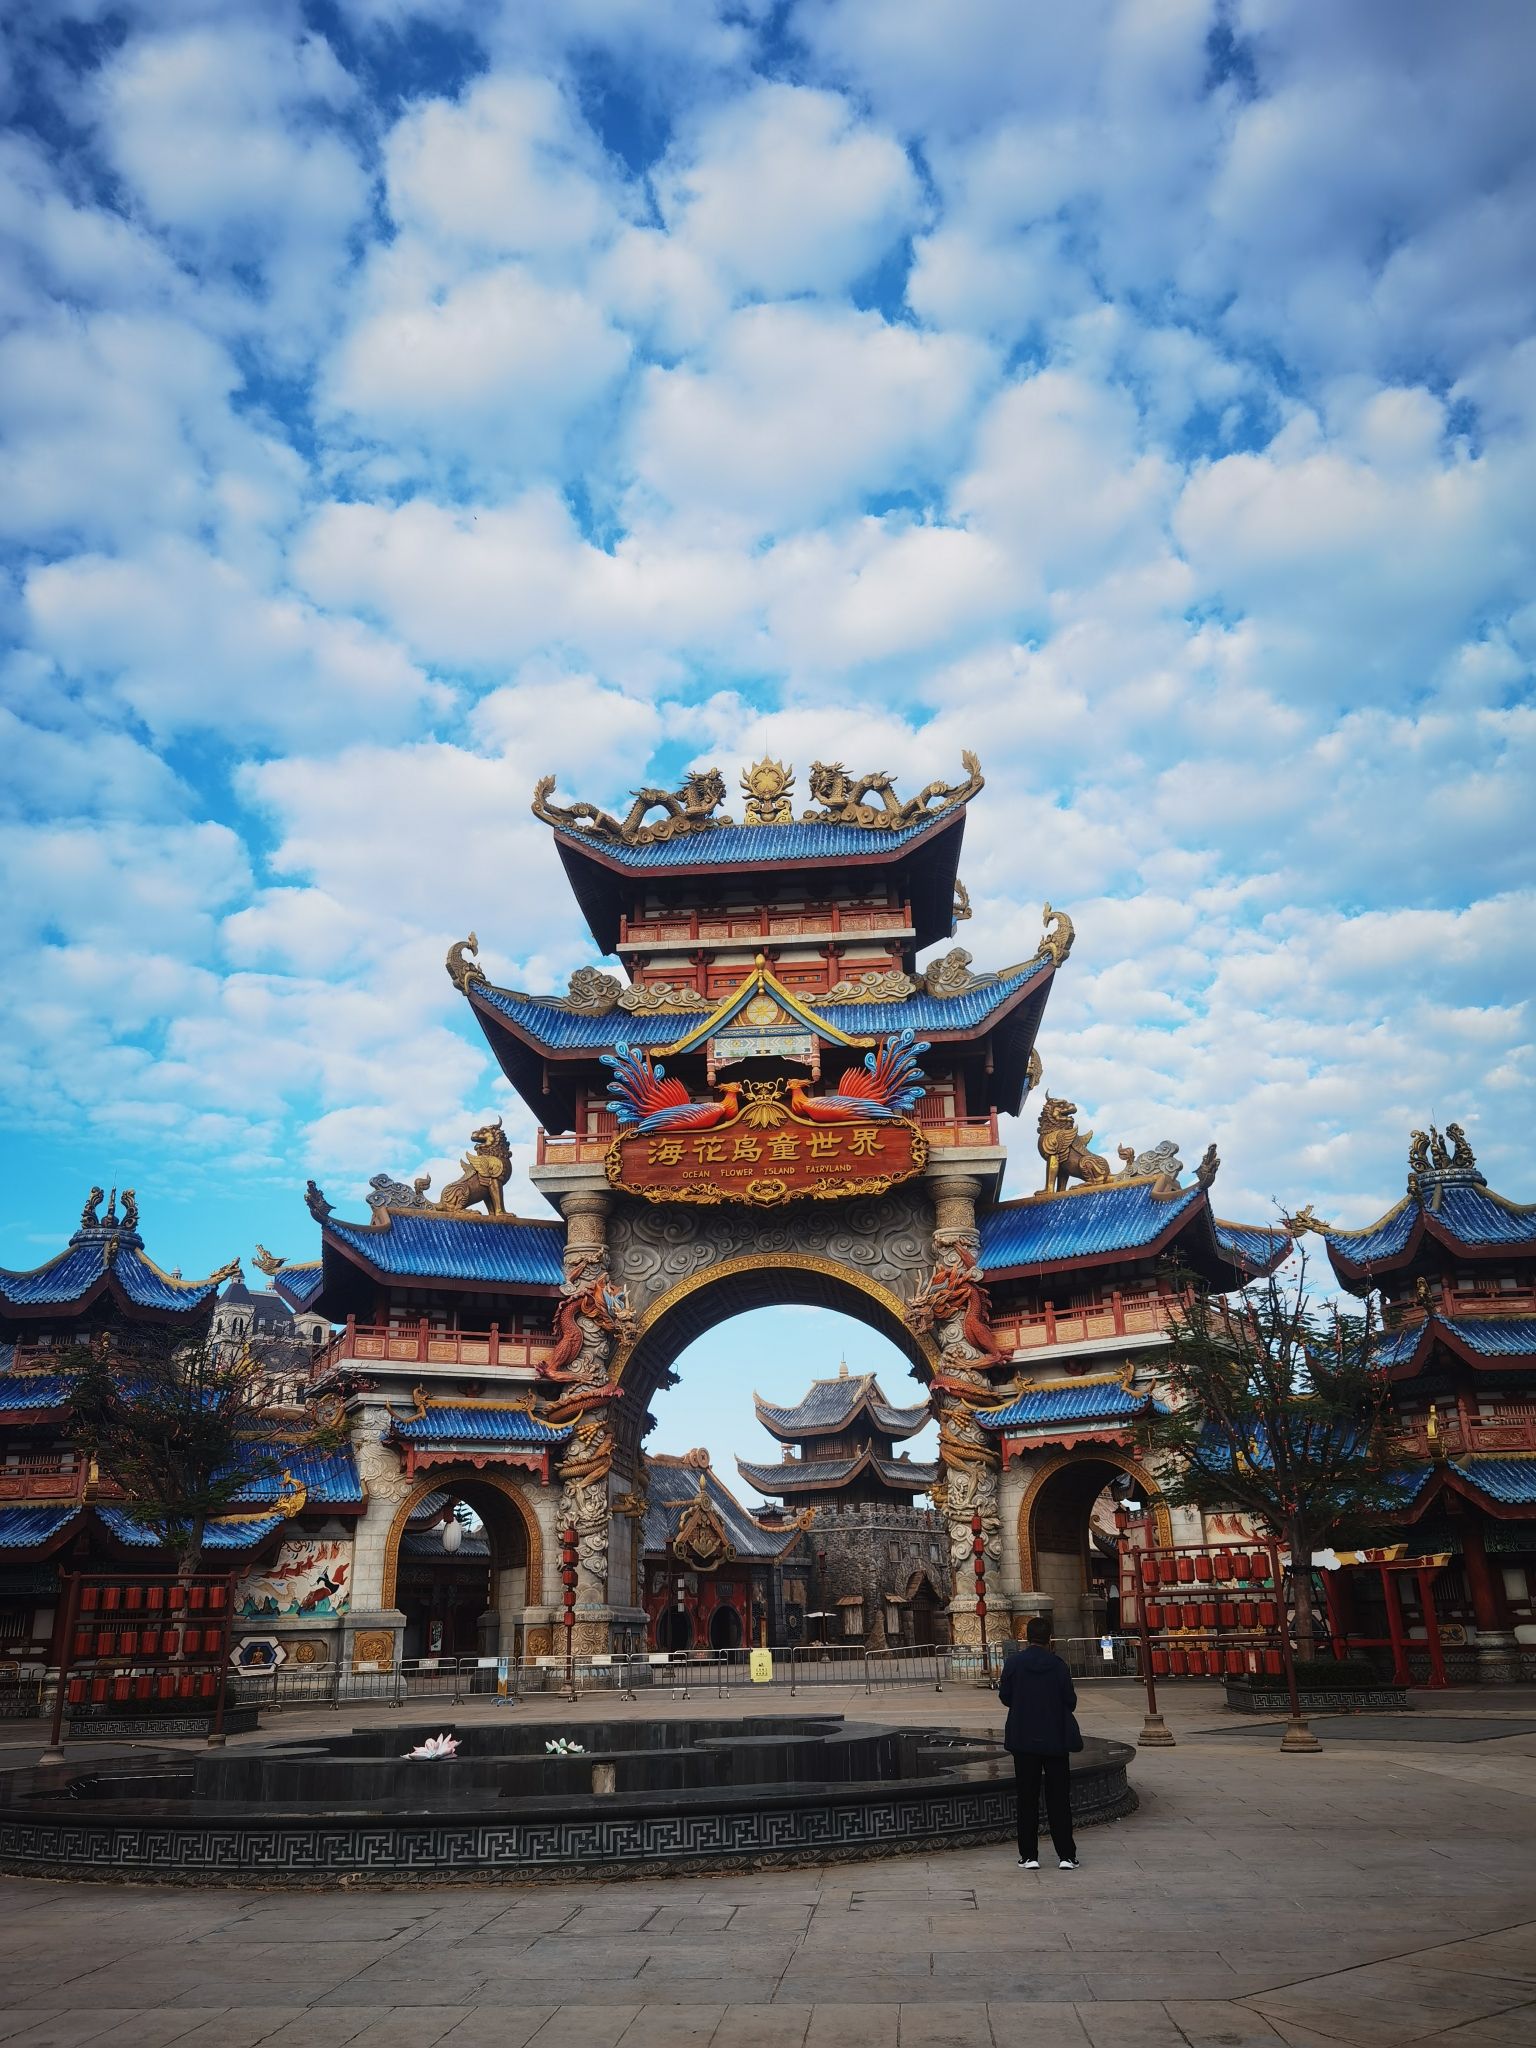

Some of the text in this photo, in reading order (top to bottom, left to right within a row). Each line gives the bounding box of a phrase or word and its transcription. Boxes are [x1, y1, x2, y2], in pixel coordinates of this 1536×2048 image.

[648, 1128, 885, 1166] 海花岛童世界
[682, 1164, 852, 1179] OCEAN FLOWER ISLAND FAIRYLAND
